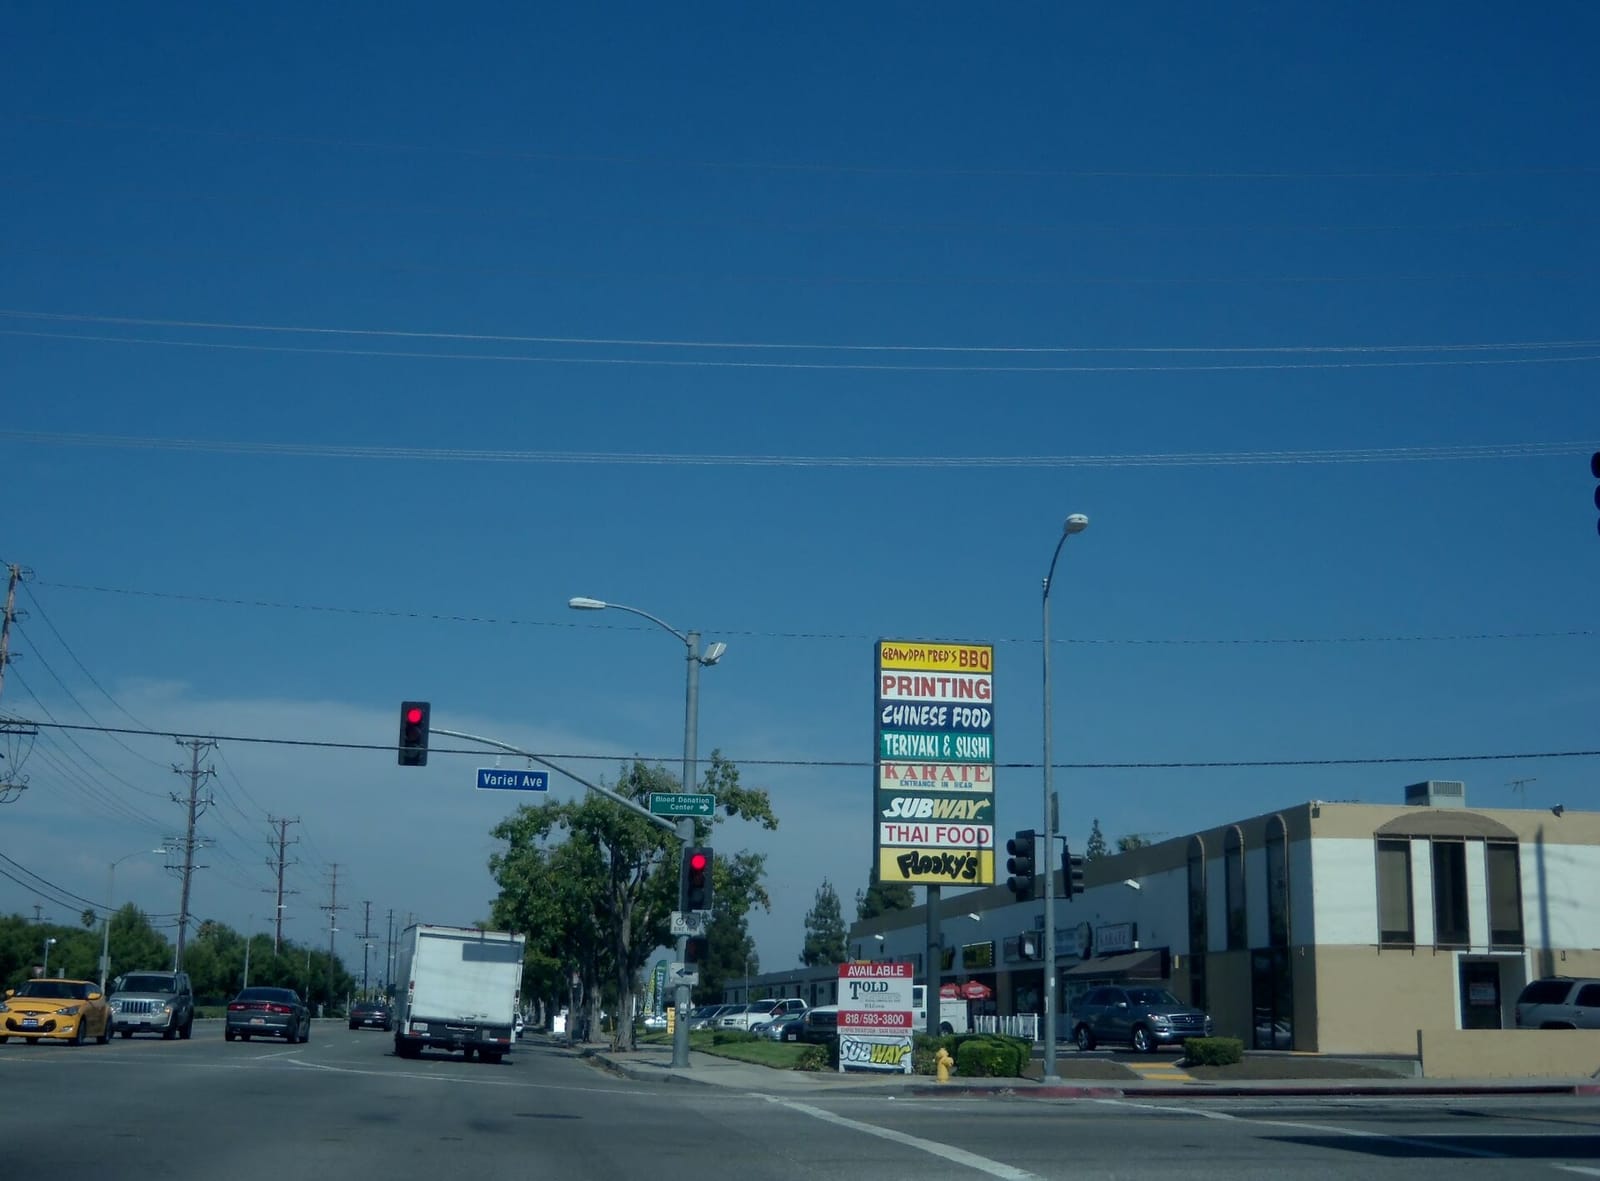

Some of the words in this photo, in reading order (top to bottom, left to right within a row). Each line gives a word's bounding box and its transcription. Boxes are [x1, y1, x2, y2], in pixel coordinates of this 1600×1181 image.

[882, 647, 925, 662] GRANDPA
[928, 649, 957, 664] FRED'S
[960, 650, 989, 671] BBQ
[882, 675, 991, 700] PRINTING
[882, 705, 947, 726] CHINESE
[952, 706, 991, 728] FOOD
[884, 733, 938, 758] TERIYAKI
[943, 735, 951, 757] &
[956, 736, 990, 759] SUSHI
[483, 773, 518, 786] Variel
[522, 775, 543, 787] Ave
[884, 763, 990, 782] KARATE
[900, 780, 936, 788] ENTRANCE
[670, 803, 694, 811] Center
[678, 796, 710, 804] Donation
[882, 797, 991, 820] SUBWAY
[885, 825, 929, 843] THAI
[936, 826, 990, 845] FOOD
[847, 965, 904, 977] AVAILABLE
[849, 981, 889, 1000] TOLD
[845, 1013, 905, 1025] 818/593-3800
[840, 1040, 912, 1065] SUBWAY
